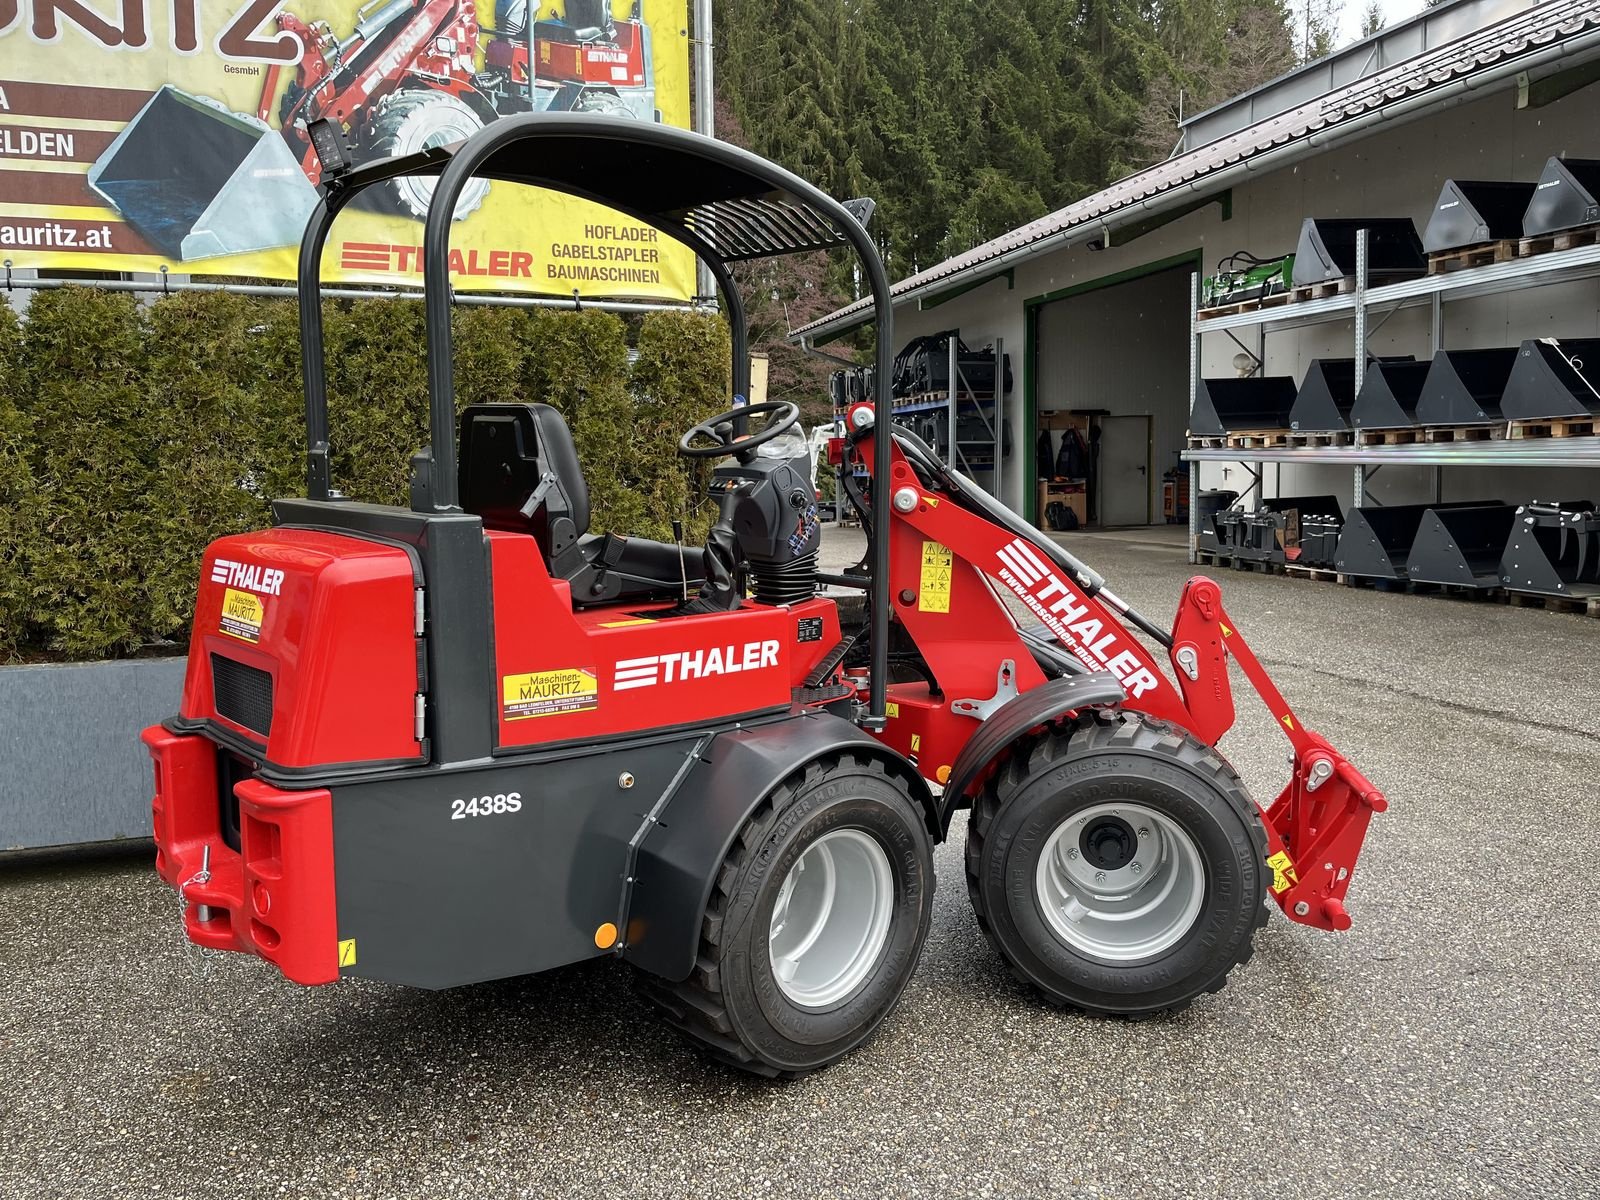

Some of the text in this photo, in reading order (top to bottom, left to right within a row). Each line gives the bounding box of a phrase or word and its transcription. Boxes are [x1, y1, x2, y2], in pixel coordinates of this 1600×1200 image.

[224, 64, 260, 77] GesmbH
[0, 130, 75, 157] LDEN
[0, 223, 113, 248] auritz.at
[584, 224, 658, 242] HOFLADER
[551, 243, 659, 263] GABELSTAPLER
[547, 263, 660, 284] BAUMASCHINEN
[228, 560, 285, 596] THALER
[228, 602, 256, 622] MAURITZ
[1036, 574, 1159, 699] THALER
[658, 639, 780, 683] THALER
[520, 680, 581, 700] MAURITZ
[530, 673, 581, 686] Maschinen-
[451, 792, 522, 820] 2438S
